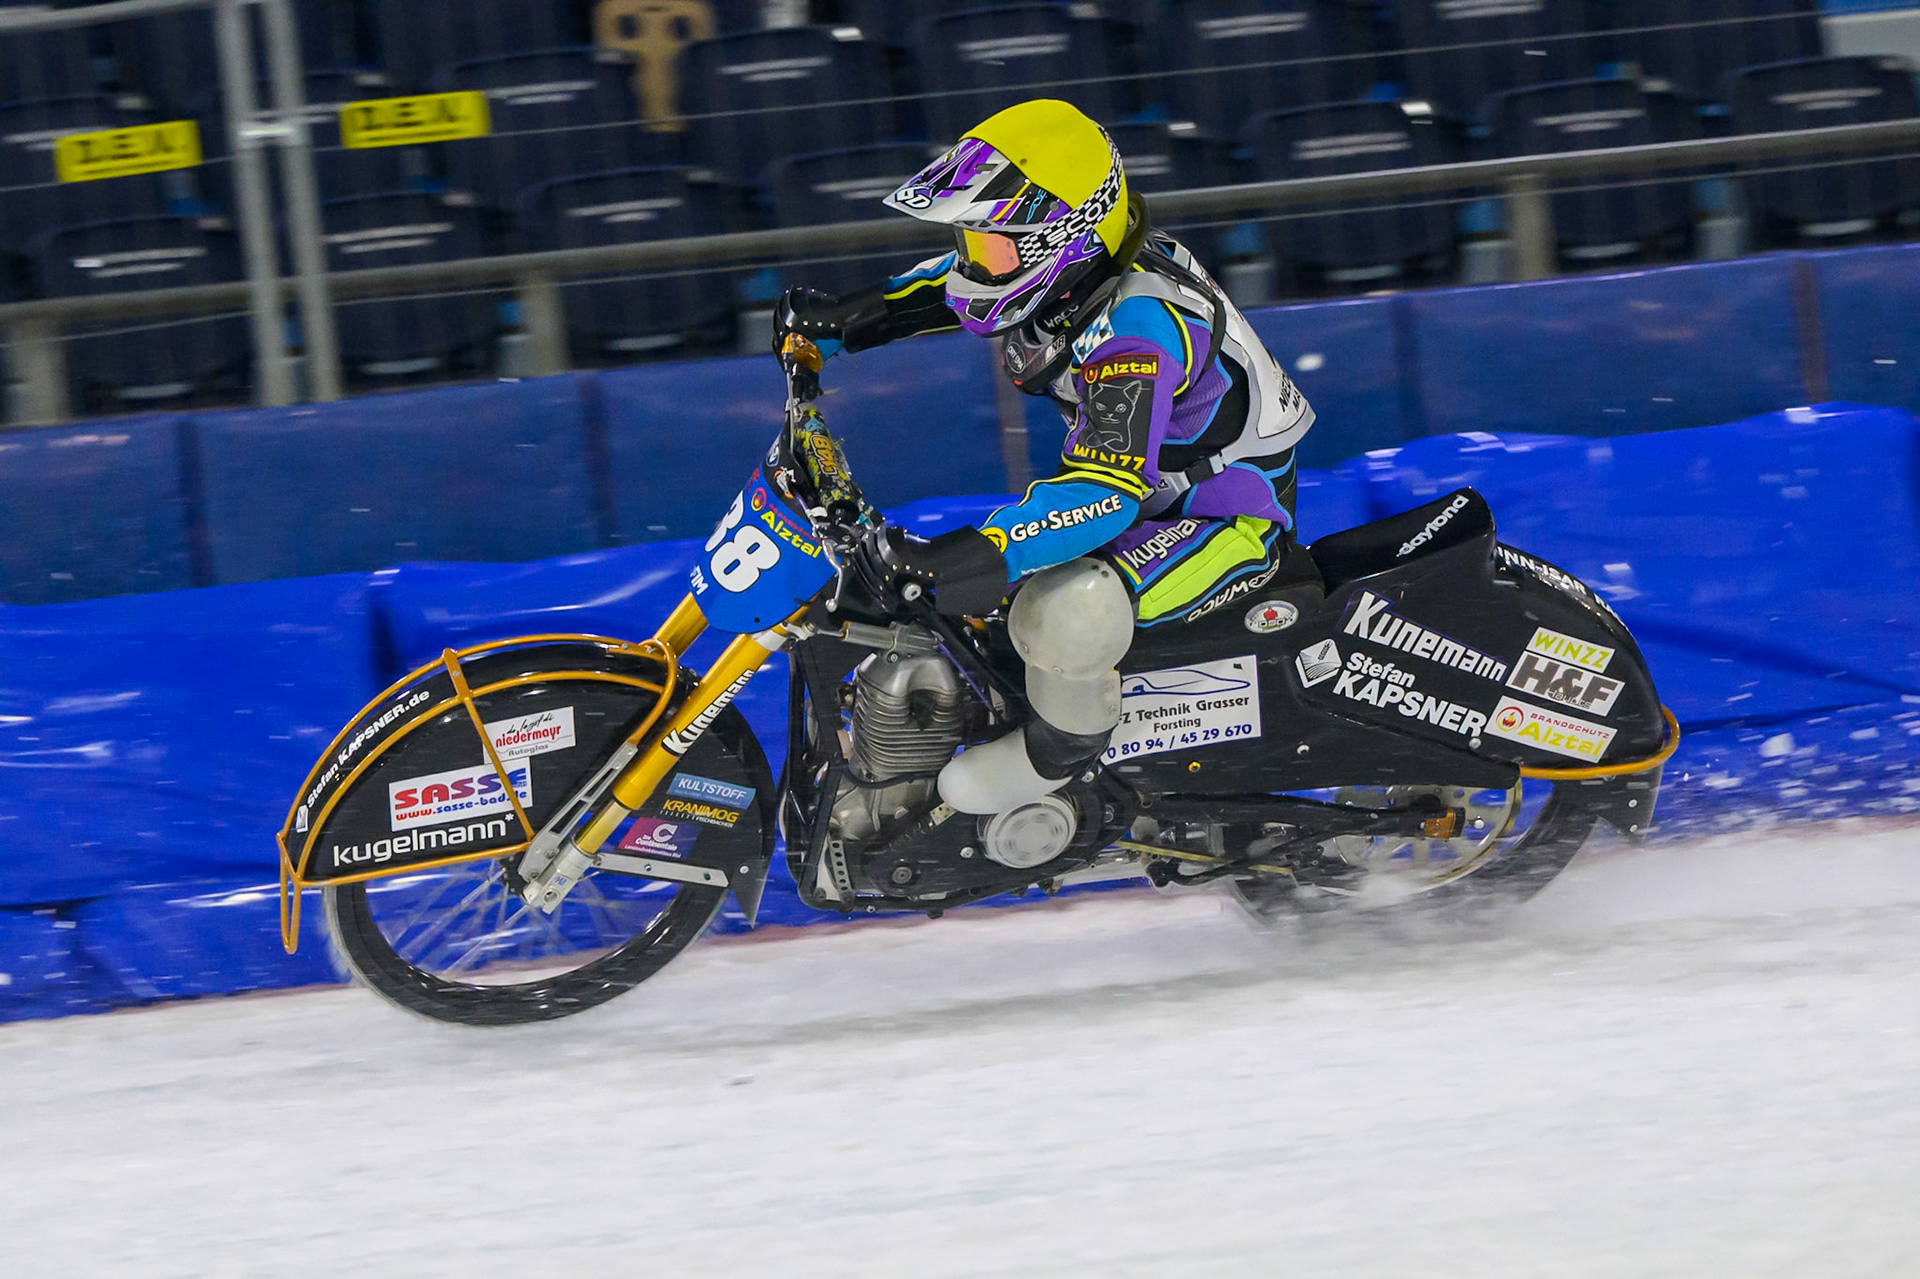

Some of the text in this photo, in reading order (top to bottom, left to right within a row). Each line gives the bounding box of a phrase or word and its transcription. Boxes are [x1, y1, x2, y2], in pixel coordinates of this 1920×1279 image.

[1046, 168, 1119, 247] SCOTT
[1100, 362, 1157, 379] Alztal
[761, 511, 822, 558] Alztal
[1396, 494, 1469, 557] daytona
[690, 564, 709, 595] FIM
[1188, 581, 1249, 622] WACO
[1343, 591, 1508, 682] Kunemann
[1535, 631, 1611, 669] WINZZ
[1346, 652, 1416, 688] Stefan
[1511, 654, 1618, 703] H&F
[662, 669, 756, 754] Kunemann
[1136, 703, 1191, 722] Technik
[1196, 696, 1250, 711] Grasser
[1332, 670, 1487, 737] KAPSNER
[496, 726, 561, 747] niedermayr
[1121, 742, 1140, 755] 80
[1145, 738, 1164, 750] 94
[1180, 732, 1198, 744] 45
[1202, 728, 1220, 741] 29
[1224, 724, 1252, 738] 670
[1154, 718, 1202, 733] Forsting
[1517, 721, 1604, 756] Alztal
[1530, 713, 1610, 739] BRANDSCHUTZ
[307, 690, 430, 808] Stefan KAPSNER.de
[395, 768, 526, 810] SASSE
[678, 778, 746, 800] KULTSTOFF
[663, 799, 739, 823] KRANIMOG
[333, 820, 506, 866] kugelmann
[635, 838, 678, 851] Continentale
